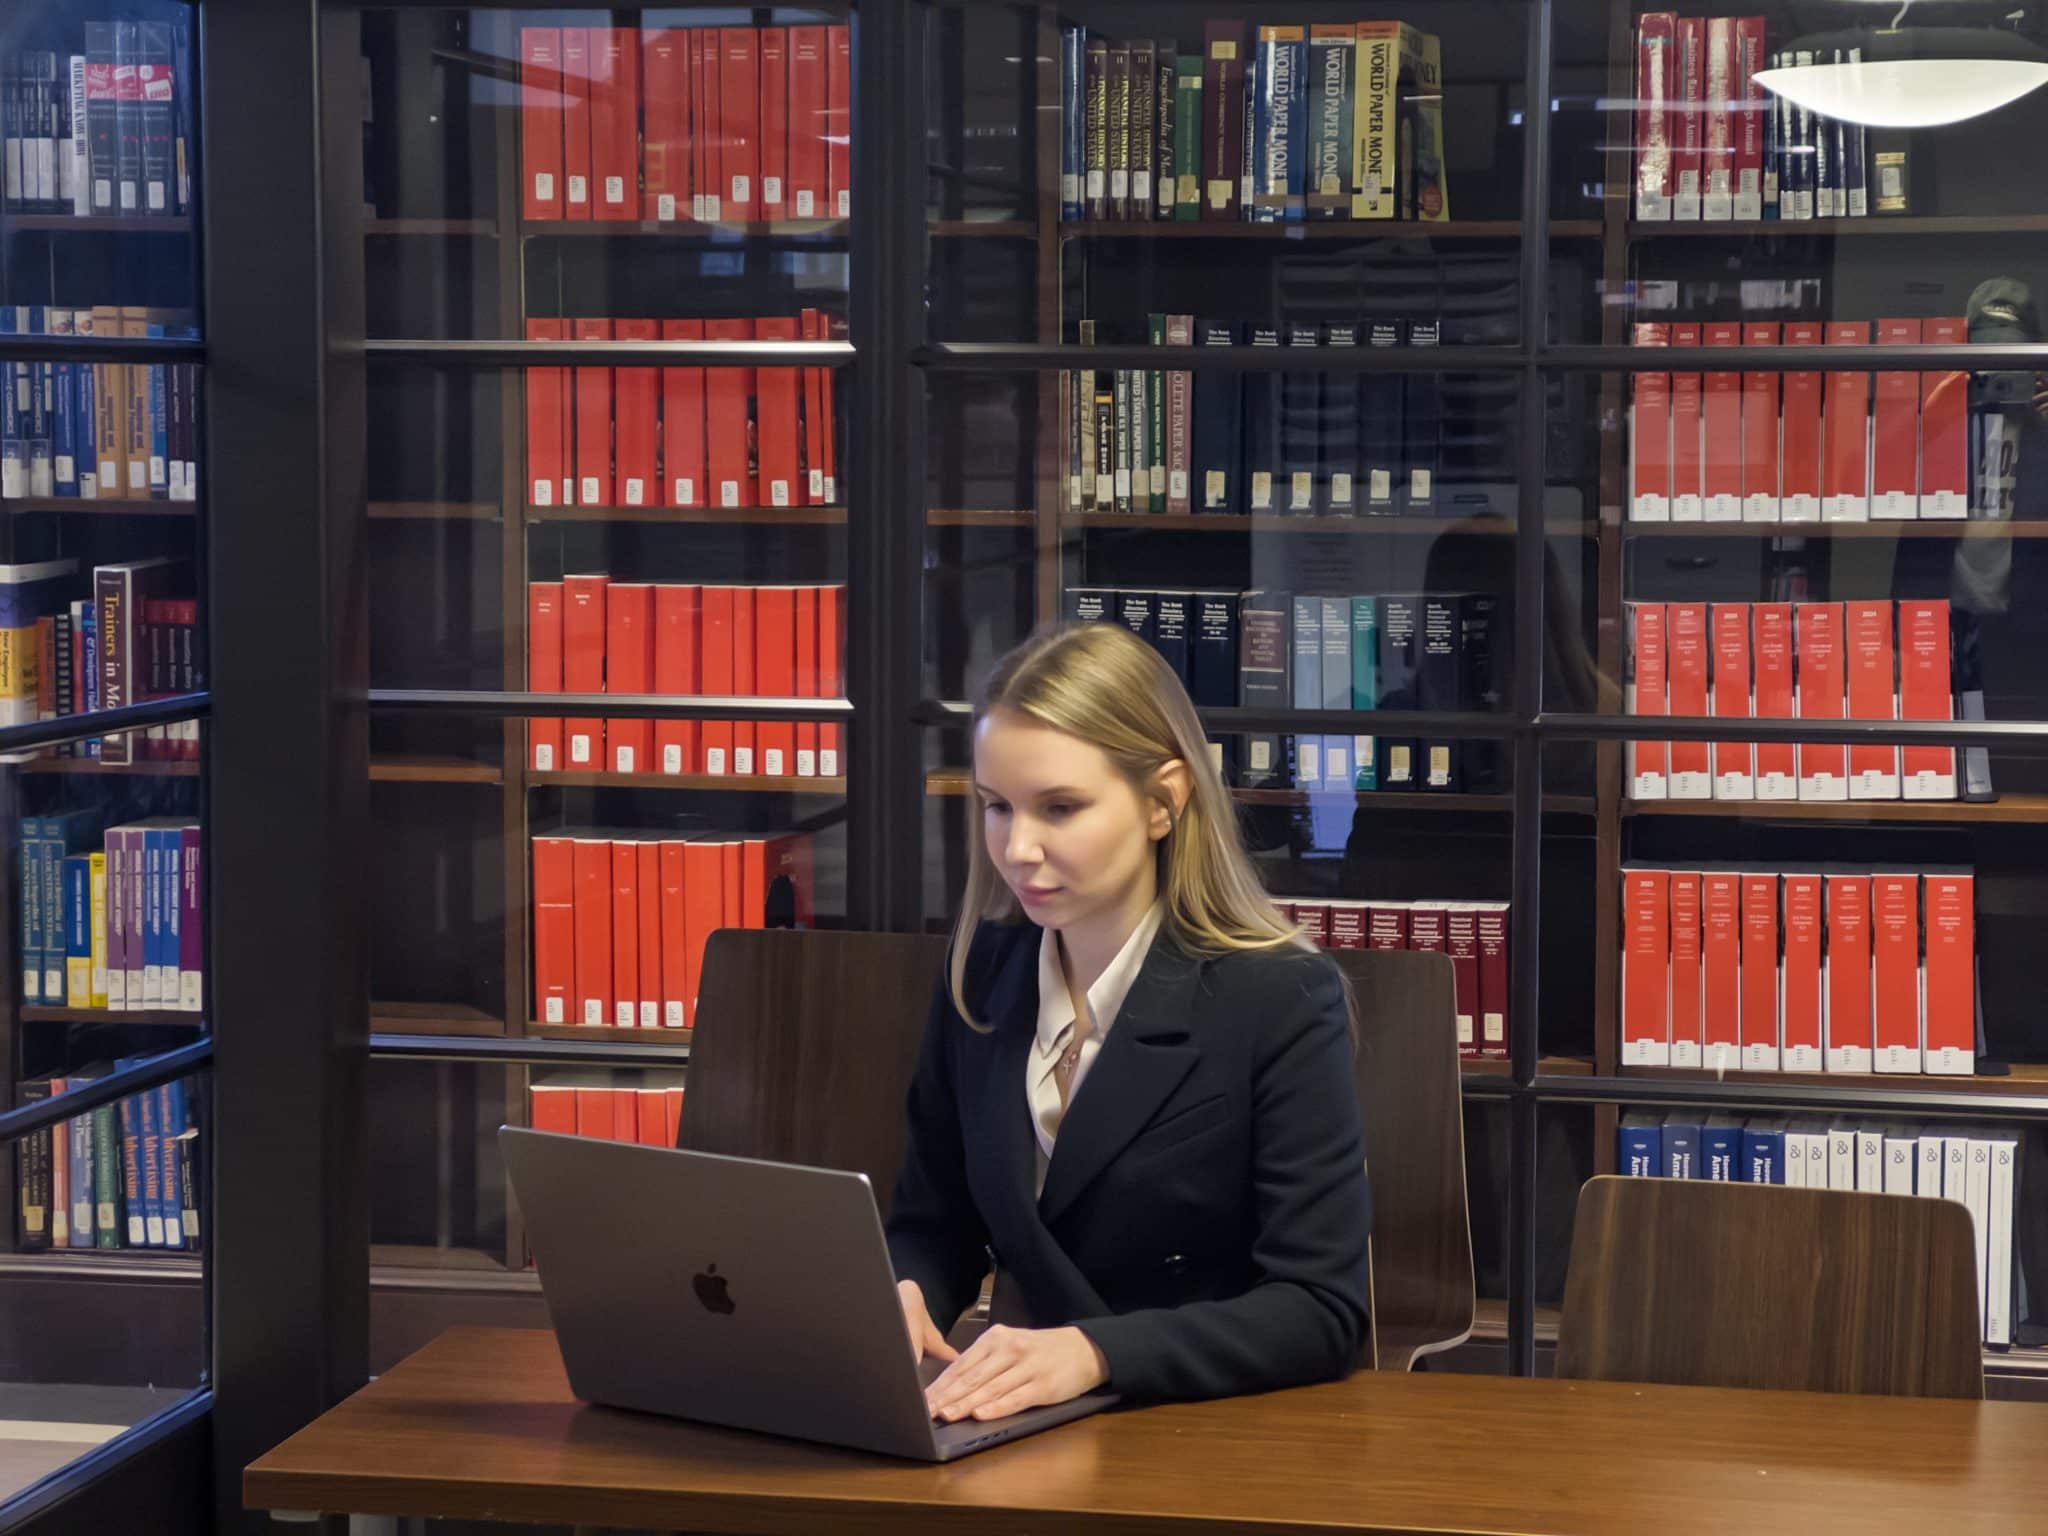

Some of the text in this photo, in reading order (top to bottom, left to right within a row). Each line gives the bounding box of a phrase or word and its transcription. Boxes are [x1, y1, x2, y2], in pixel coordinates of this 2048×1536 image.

[73, 62, 85, 110] MARKETING
[1158, 67, 1174, 137] Encyclopedia
[1273, 47, 1289, 180] WORLD PAPER MONE
[1323, 48, 1340, 177] WORLD PAPER MON
[1368, 43, 1385, 175] WORLD PAPER MONE
[1087, 88, 1097, 168] UNITED STATES
[1110, 88, 1120, 168] UNITED STATES
[1133, 88, 1143, 168] UNITED STATES
[1745, 122, 1755, 154] Annual
[1133, 397, 1141, 425] STATES
[104, 592, 120, 657] Trainers
[105, 661, 120, 677] in
